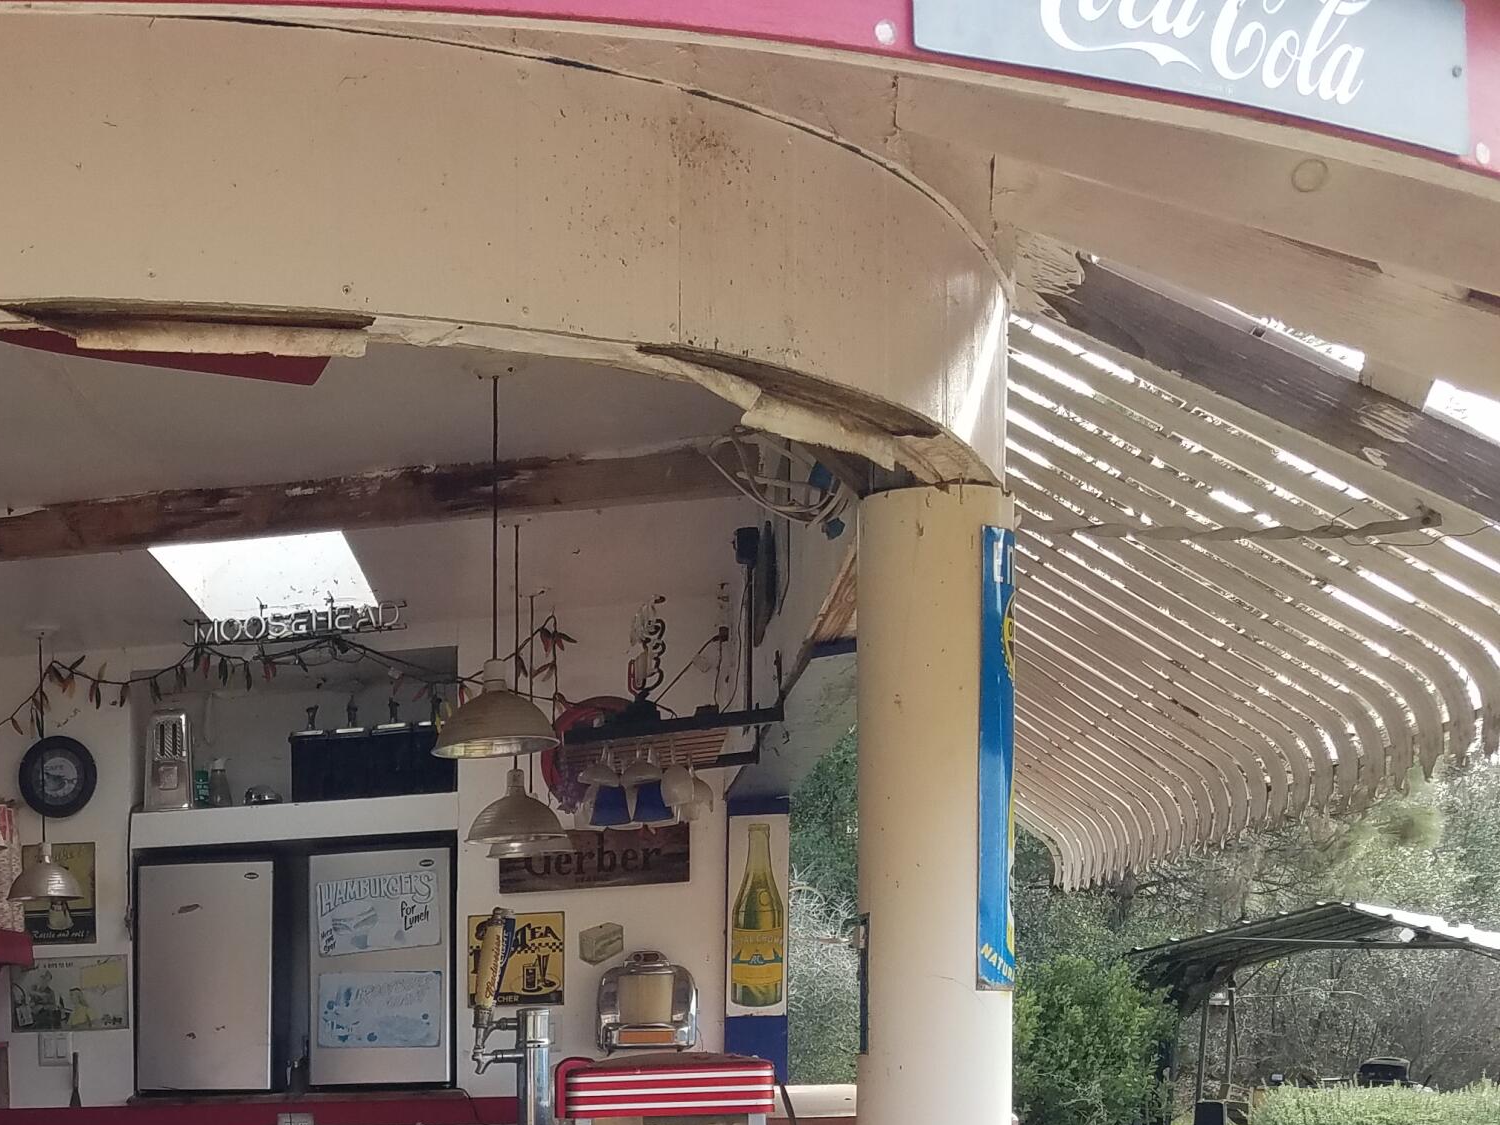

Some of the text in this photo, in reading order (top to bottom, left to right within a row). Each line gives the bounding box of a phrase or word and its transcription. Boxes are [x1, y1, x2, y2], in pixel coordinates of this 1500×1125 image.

[195, 601, 400, 643] MOOSEHEAD
[318, 872, 434, 916] HAMBURGERS
[404, 908, 429, 930] Lunch
